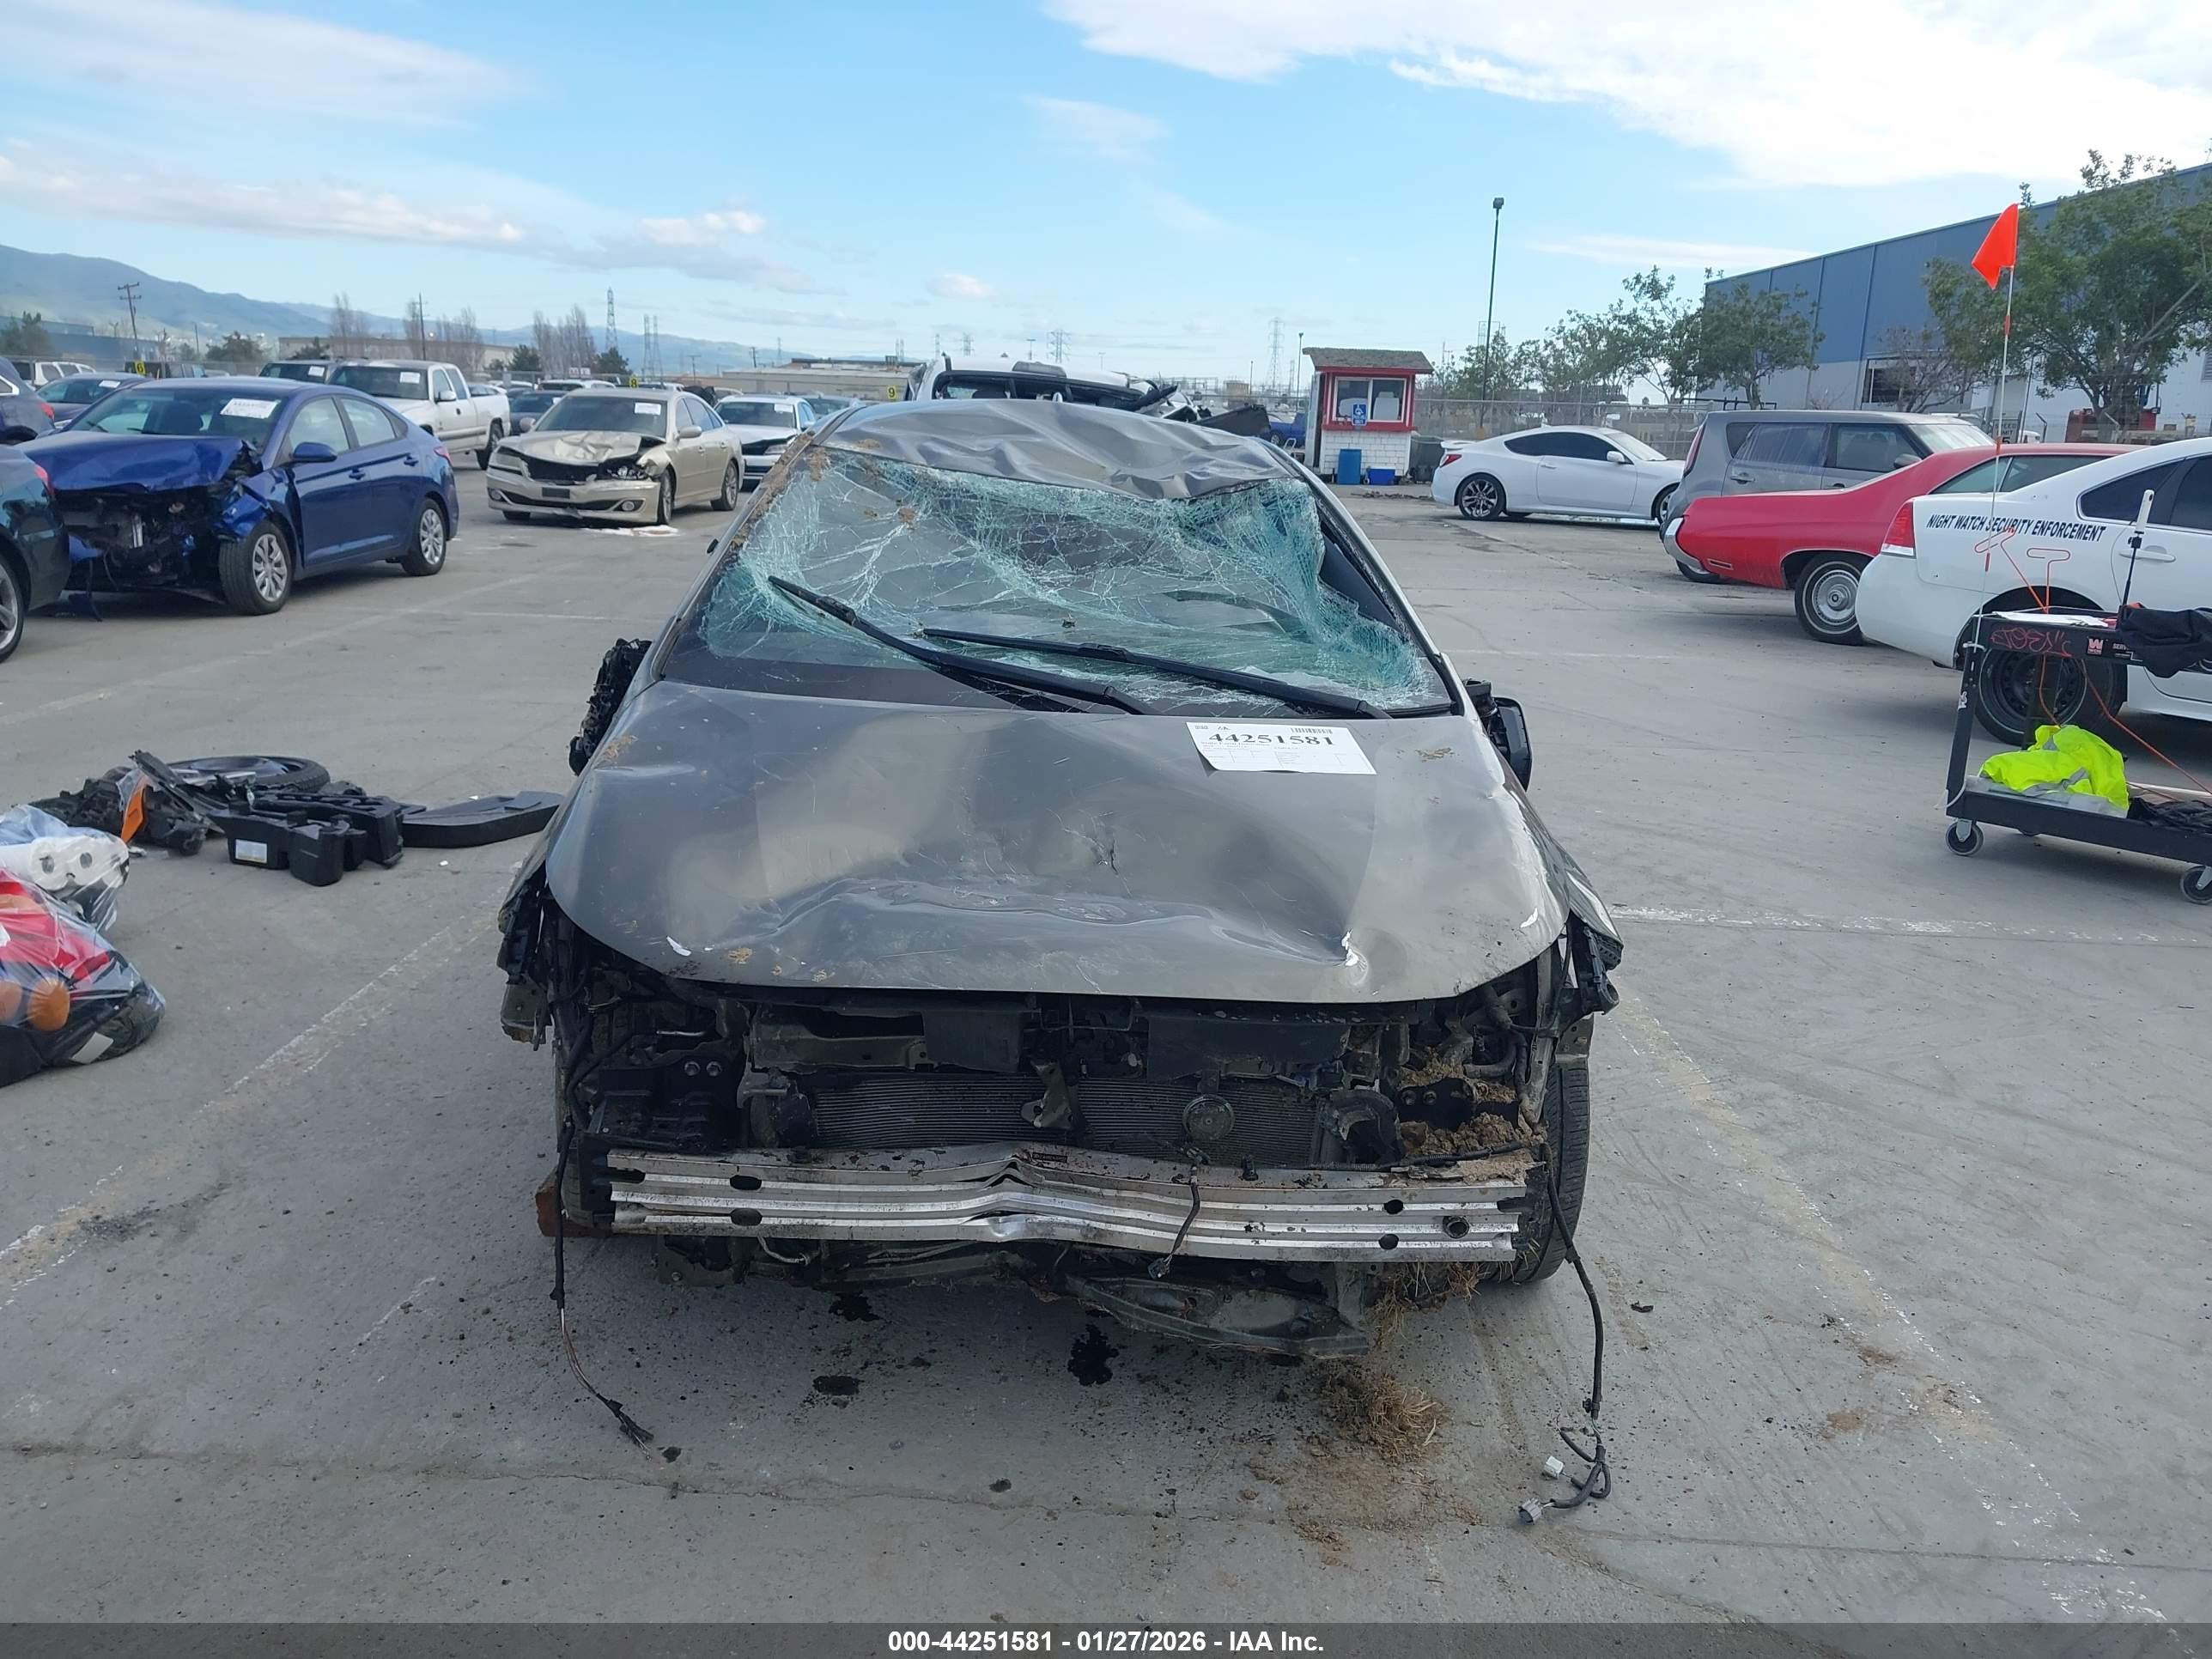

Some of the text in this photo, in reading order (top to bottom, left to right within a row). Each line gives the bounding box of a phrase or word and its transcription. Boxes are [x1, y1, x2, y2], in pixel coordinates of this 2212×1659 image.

[888, 386, 896, 398] 9
[1926, 514, 2106, 542] NIGHT WATCH SECURITY ENFORCEMENT
[1209, 733, 1334, 745] 44251581
